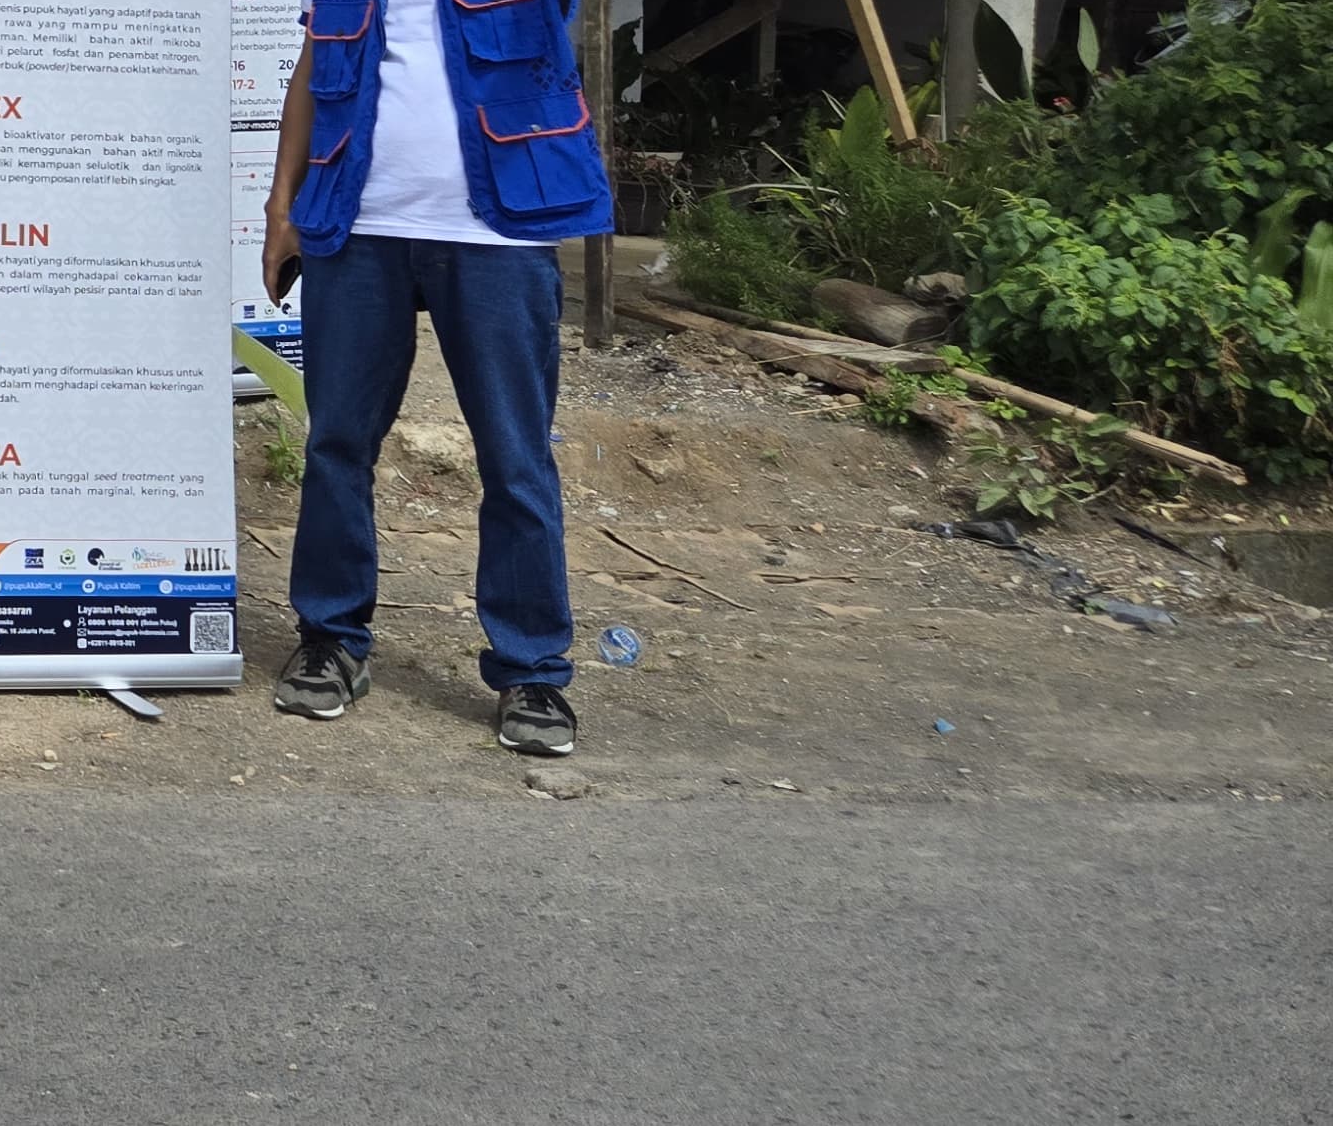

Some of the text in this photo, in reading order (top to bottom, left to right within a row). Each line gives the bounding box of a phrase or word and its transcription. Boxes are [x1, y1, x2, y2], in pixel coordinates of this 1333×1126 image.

[13, 472, 44, 482] hayati
[49, 472, 89, 482] tunggal
[94, 472, 117, 481] seed
[122, 473, 174, 482] treatment
[179, 474, 204, 484] yang
